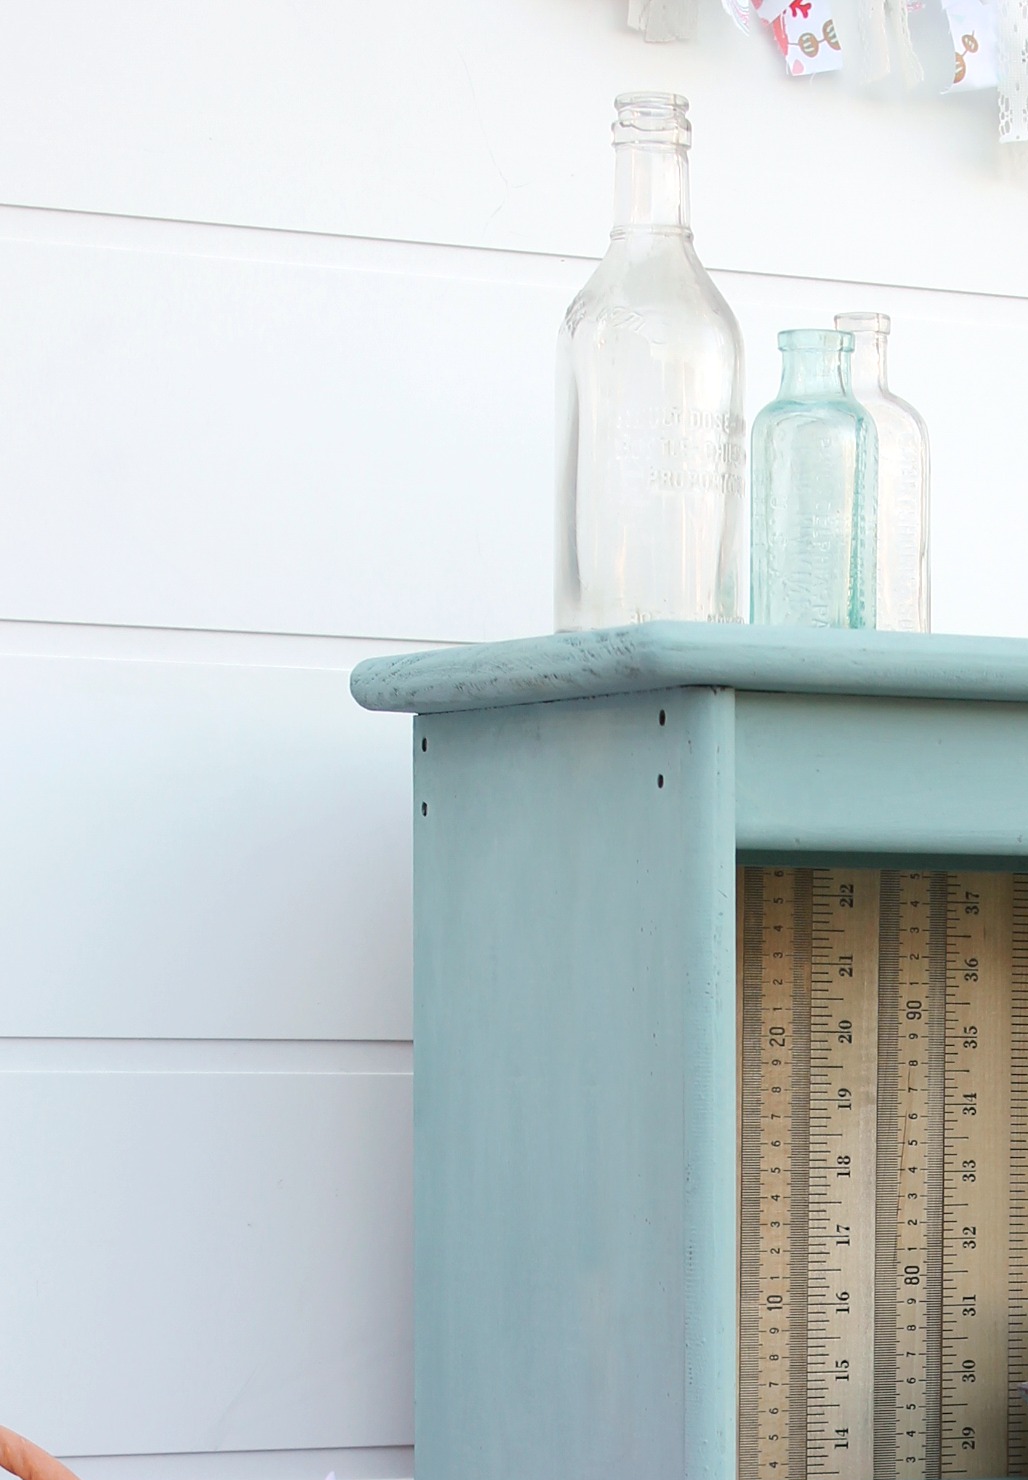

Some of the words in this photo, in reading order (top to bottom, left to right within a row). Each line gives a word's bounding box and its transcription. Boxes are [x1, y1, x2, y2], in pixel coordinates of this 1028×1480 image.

[840, 883, 854, 908] 22
[966, 892, 979, 915] 37
[839, 954, 853, 978] 21
[964, 958, 978, 982] 36
[906, 1000, 922, 1020] 90
[770, 1026, 786, 1047] 20
[838, 1020, 852, 1044] 20
[963, 1025, 978, 1049] 35
[838, 1088, 852, 1110] 19
[962, 1092, 977, 1116] 34
[837, 1155, 851, 1178] 18
[962, 1160, 976, 1182] 33
[836, 1224, 850, 1247] 17
[962, 1226, 976, 1249] 32
[904, 1266, 920, 1285] 80
[767, 1295, 783, 1310] 10
[836, 1292, 850, 1314] 16
[962, 1294, 976, 1316] 31
[835, 1360, 849, 1382] 15
[962, 1360, 976, 1382] 30
[834, 1427, 848, 1450] 14
[962, 1427, 976, 1450] 29
